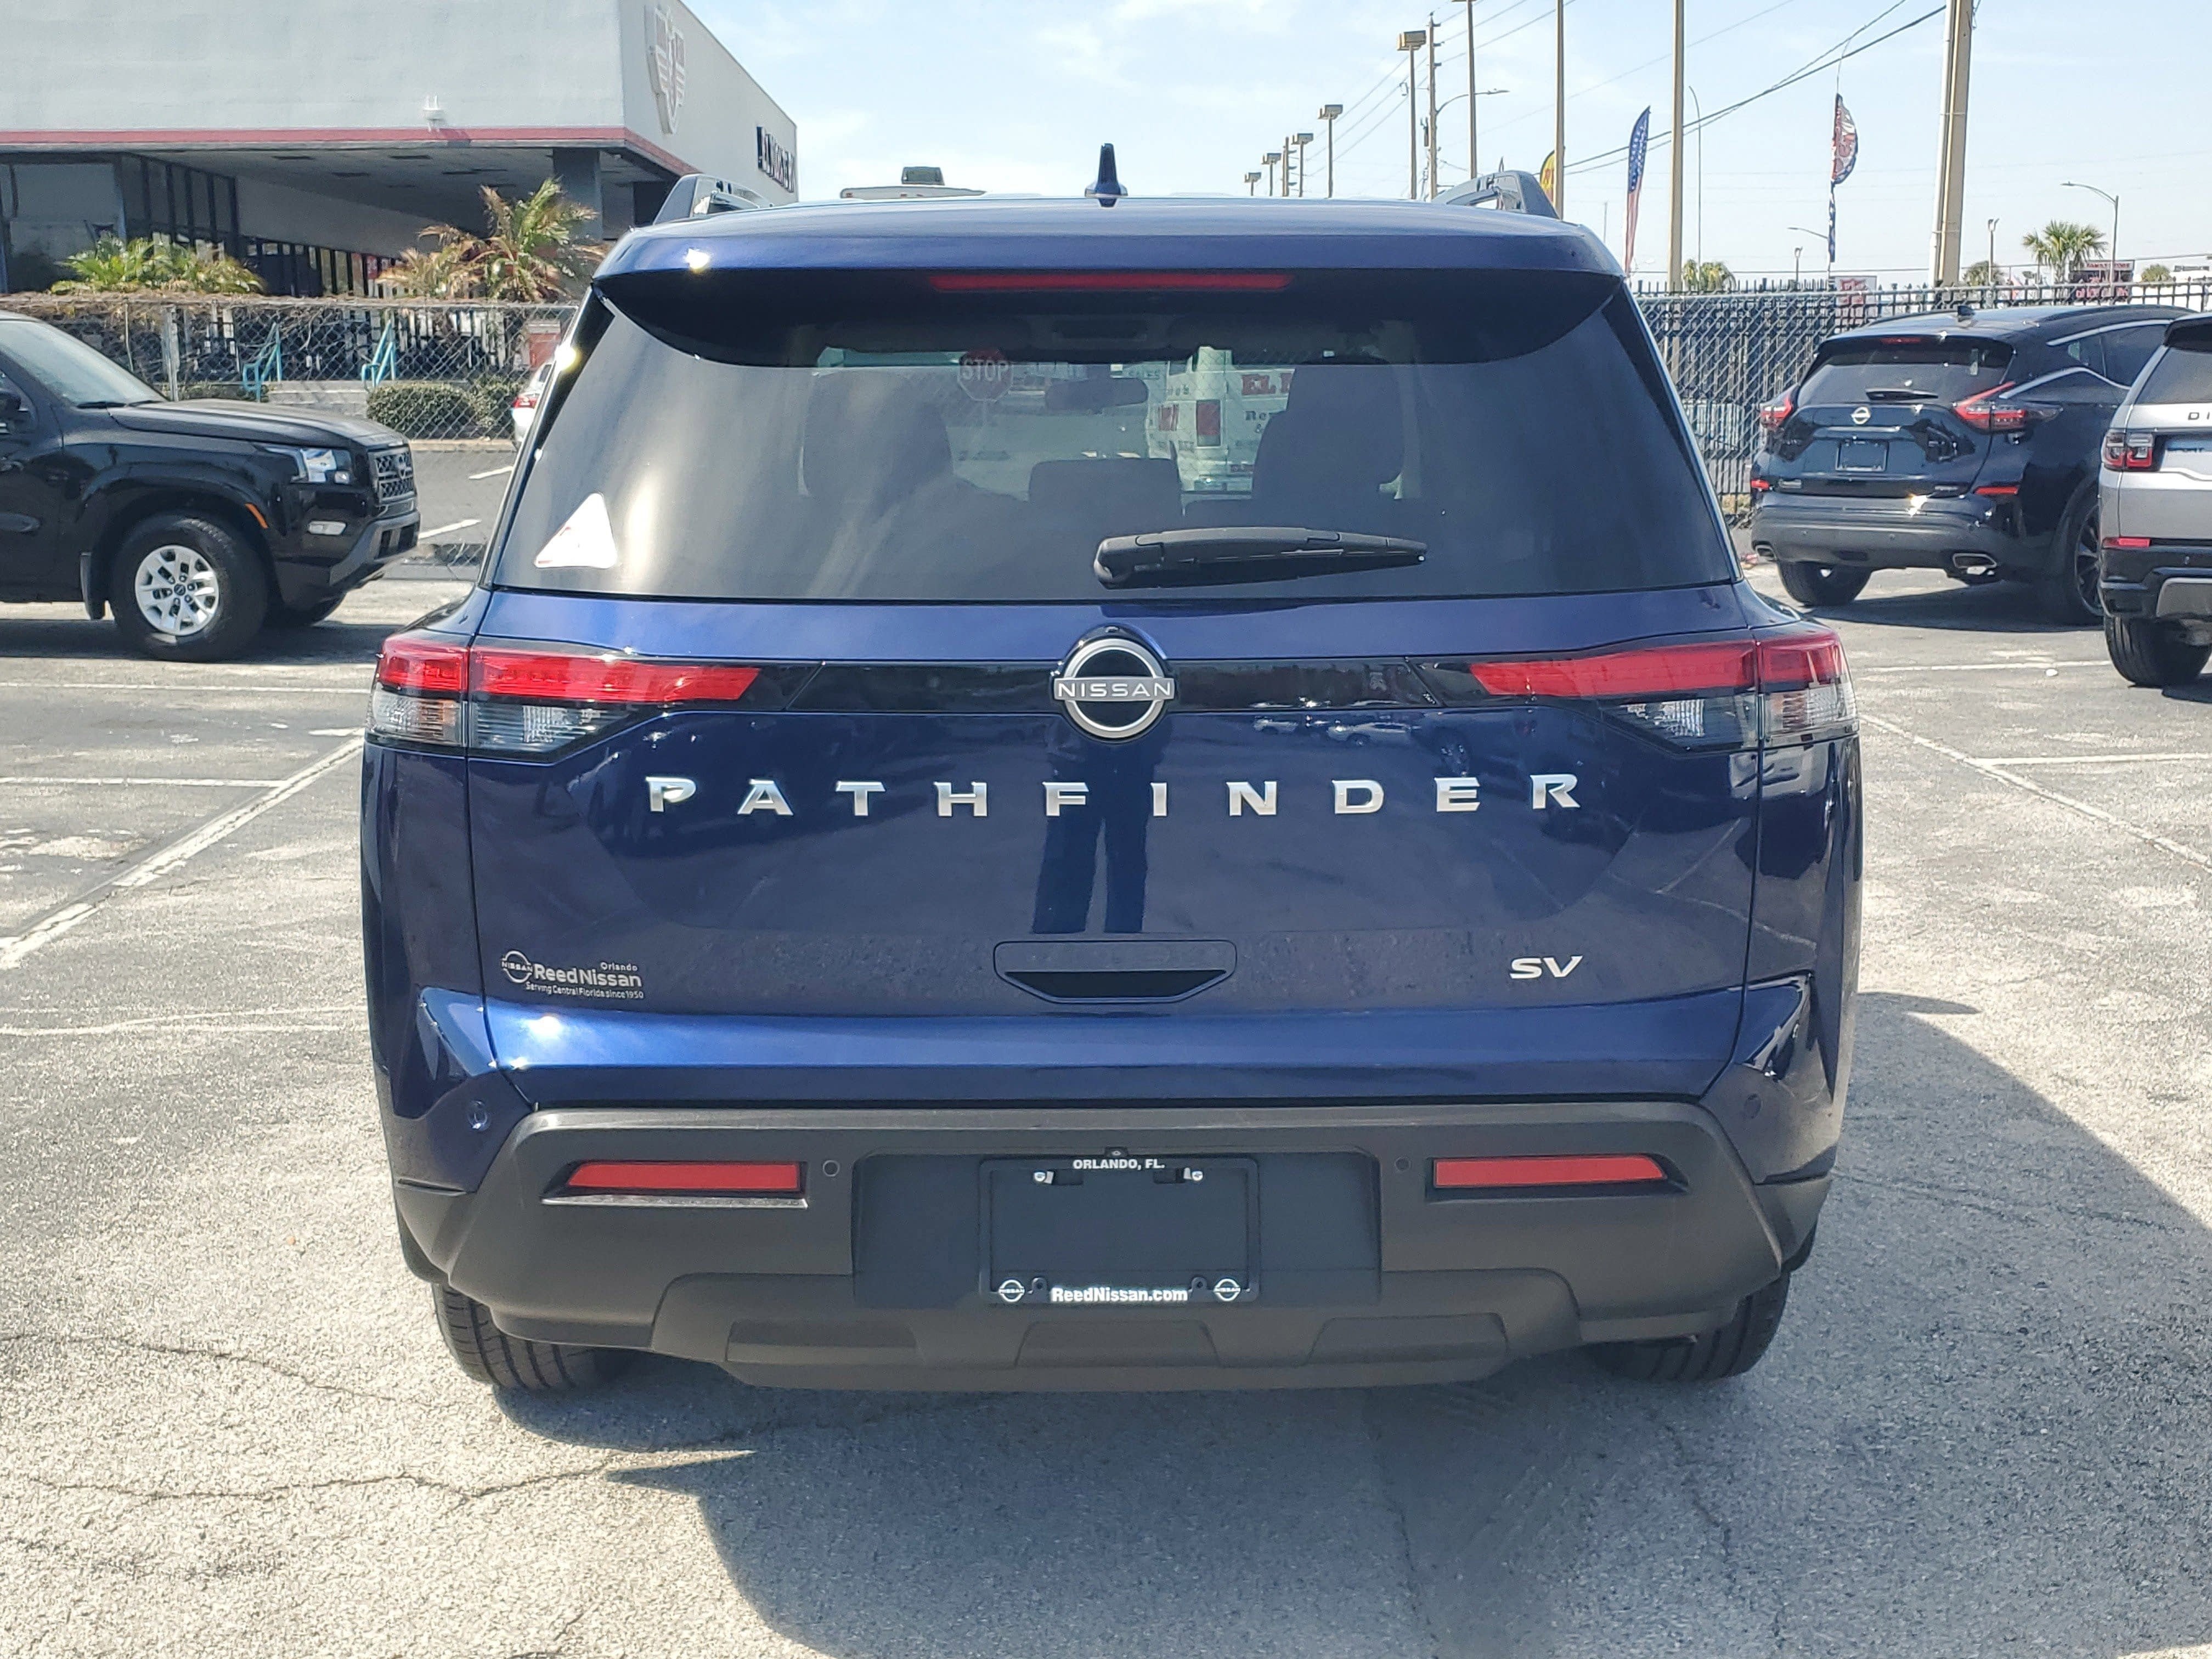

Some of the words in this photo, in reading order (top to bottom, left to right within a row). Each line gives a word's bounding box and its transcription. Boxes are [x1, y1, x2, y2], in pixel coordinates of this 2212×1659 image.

[962, 358, 1009, 381] STOP
[1058, 682, 1171, 697] NISSAN
[645, 773, 1581, 816] PATHFINDER
[501, 961, 533, 972] NISSAN
[600, 962, 637, 971] Orlando
[1509, 955, 1583, 979] SV
[526, 981, 551, 995] Serving
[553, 985, 578, 996] Central
[579, 987, 605, 997] Florida
[1073, 1159, 1142, 1171] ORLANDO,
[1145, 1159, 1165, 1169] FL.
[1051, 1286, 1188, 1302] ReedNissan.com
